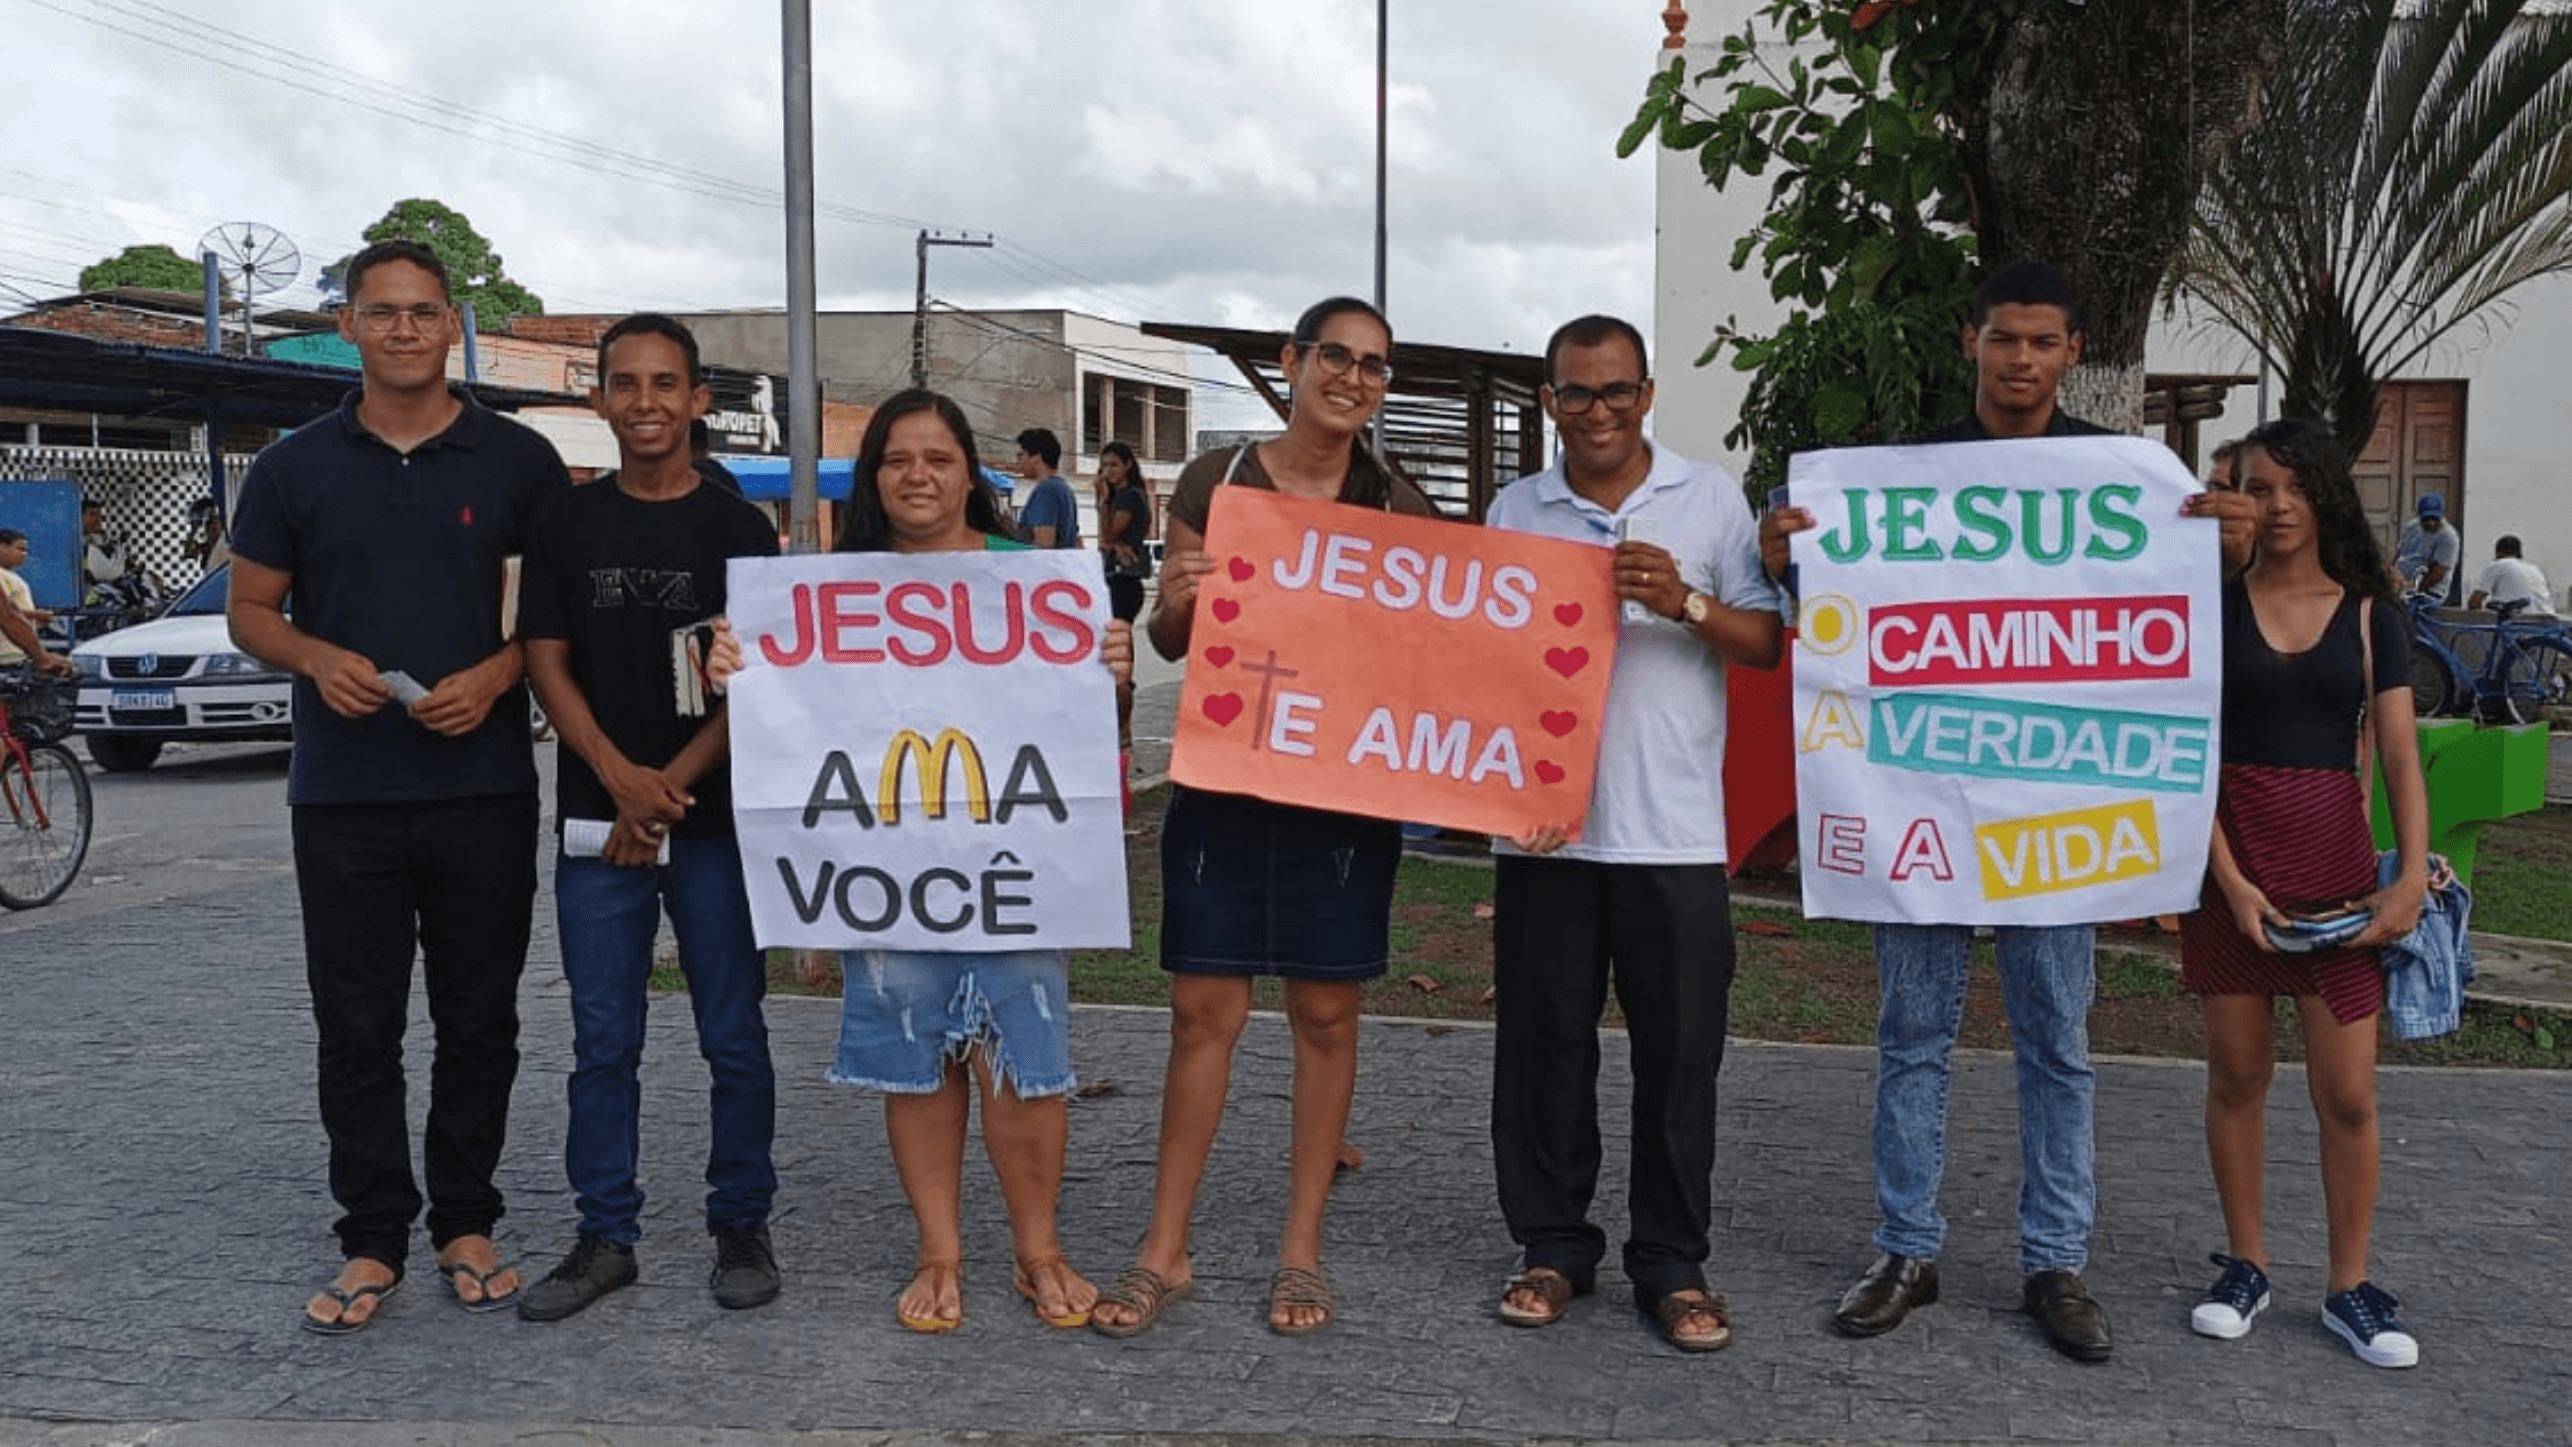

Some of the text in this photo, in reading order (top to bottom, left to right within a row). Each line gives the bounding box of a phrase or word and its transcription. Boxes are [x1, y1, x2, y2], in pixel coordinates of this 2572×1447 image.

[1819, 484, 2148, 565] JESUS
[1273, 529, 1538, 628] JESUS
[759, 579, 1094, 666] JESUS
[1800, 594, 2187, 673] O CAMINHO
[1348, 708, 1524, 789] AMA
[1800, 689, 2210, 783] A VERDADE
[802, 727, 1068, 829] AMA
[1818, 814, 2154, 886] E A VIDA
[776, 851, 1038, 934] VOCÊ
